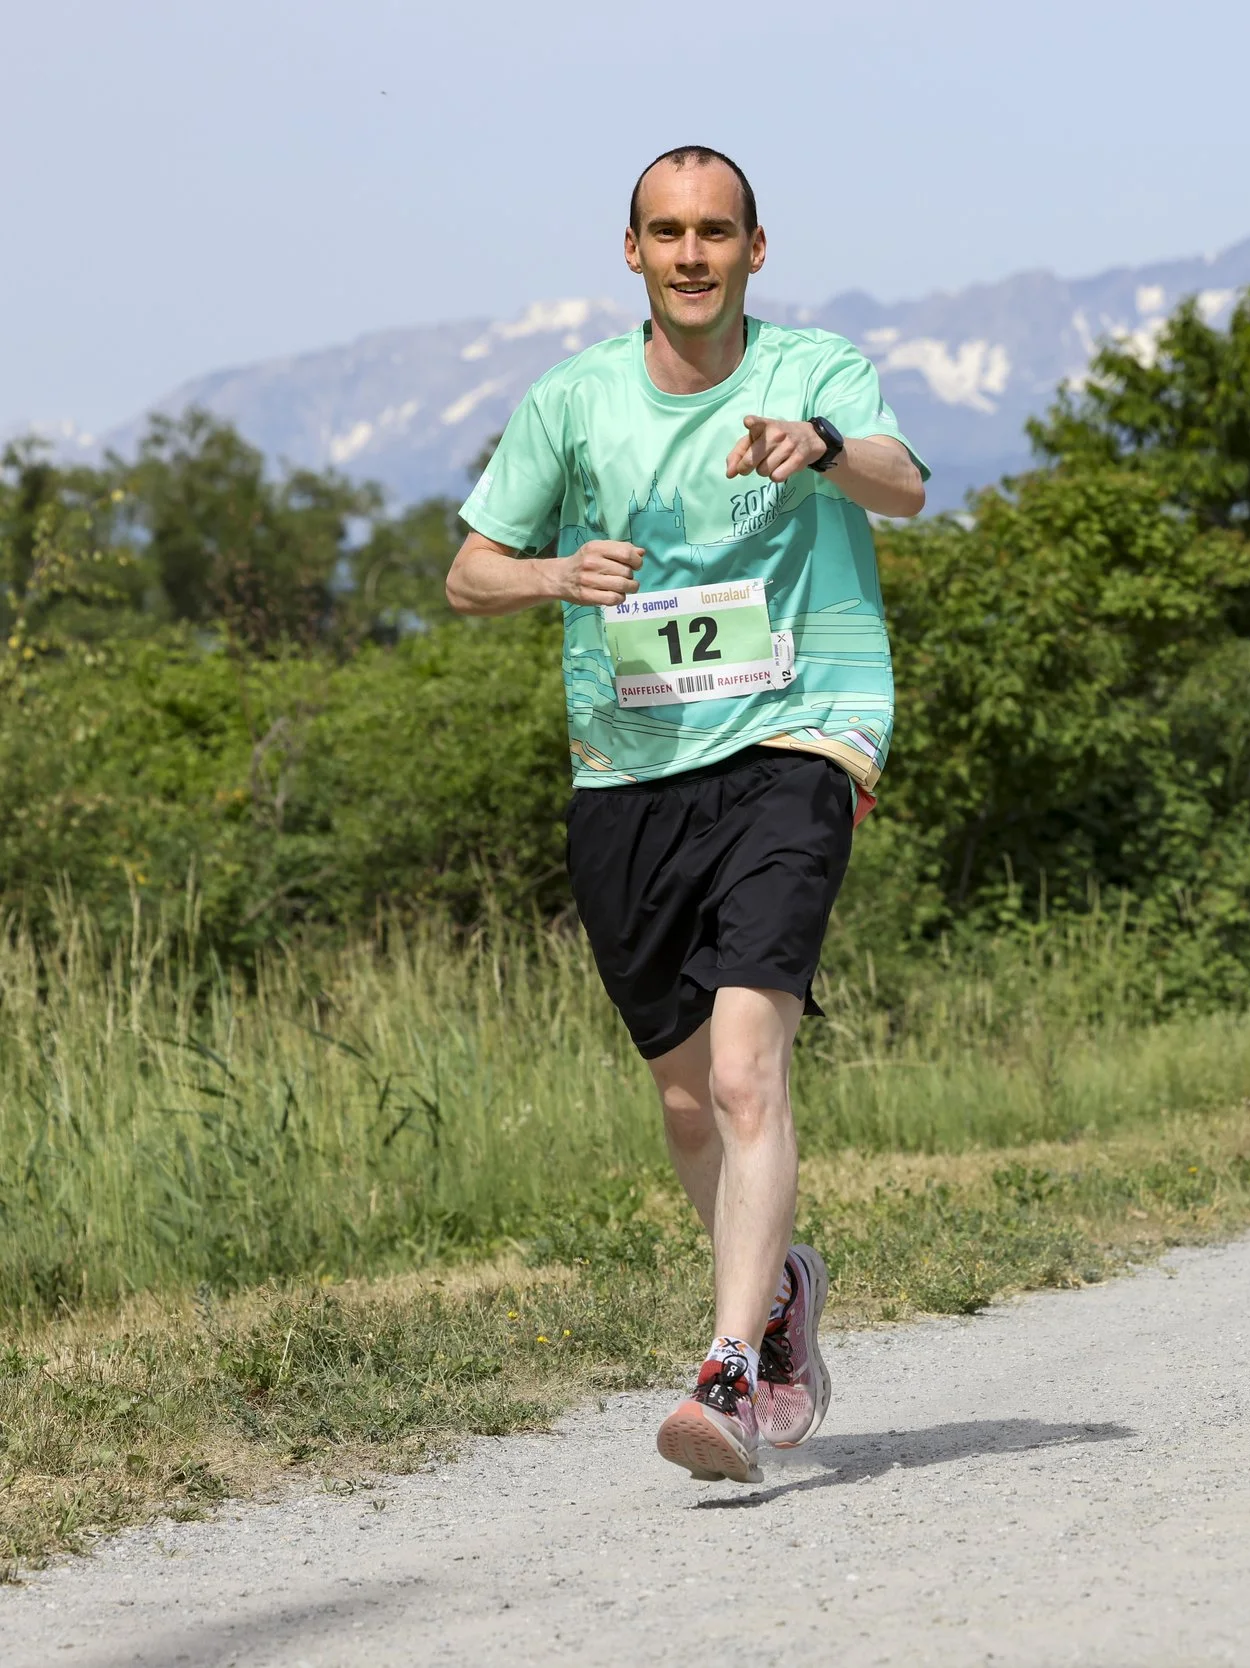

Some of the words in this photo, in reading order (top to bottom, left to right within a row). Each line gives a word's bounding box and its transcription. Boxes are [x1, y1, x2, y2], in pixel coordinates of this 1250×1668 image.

[701, 586, 751, 605] lonzalauf
[616, 602, 630, 614] stv
[642, 597, 678, 613] gampel
[657, 616, 722, 665] 12
[717, 671, 771, 686] RAIFFEISEN
[782, 669, 791, 683] 12
[621, 684, 673, 696] RAIFFEISEN
